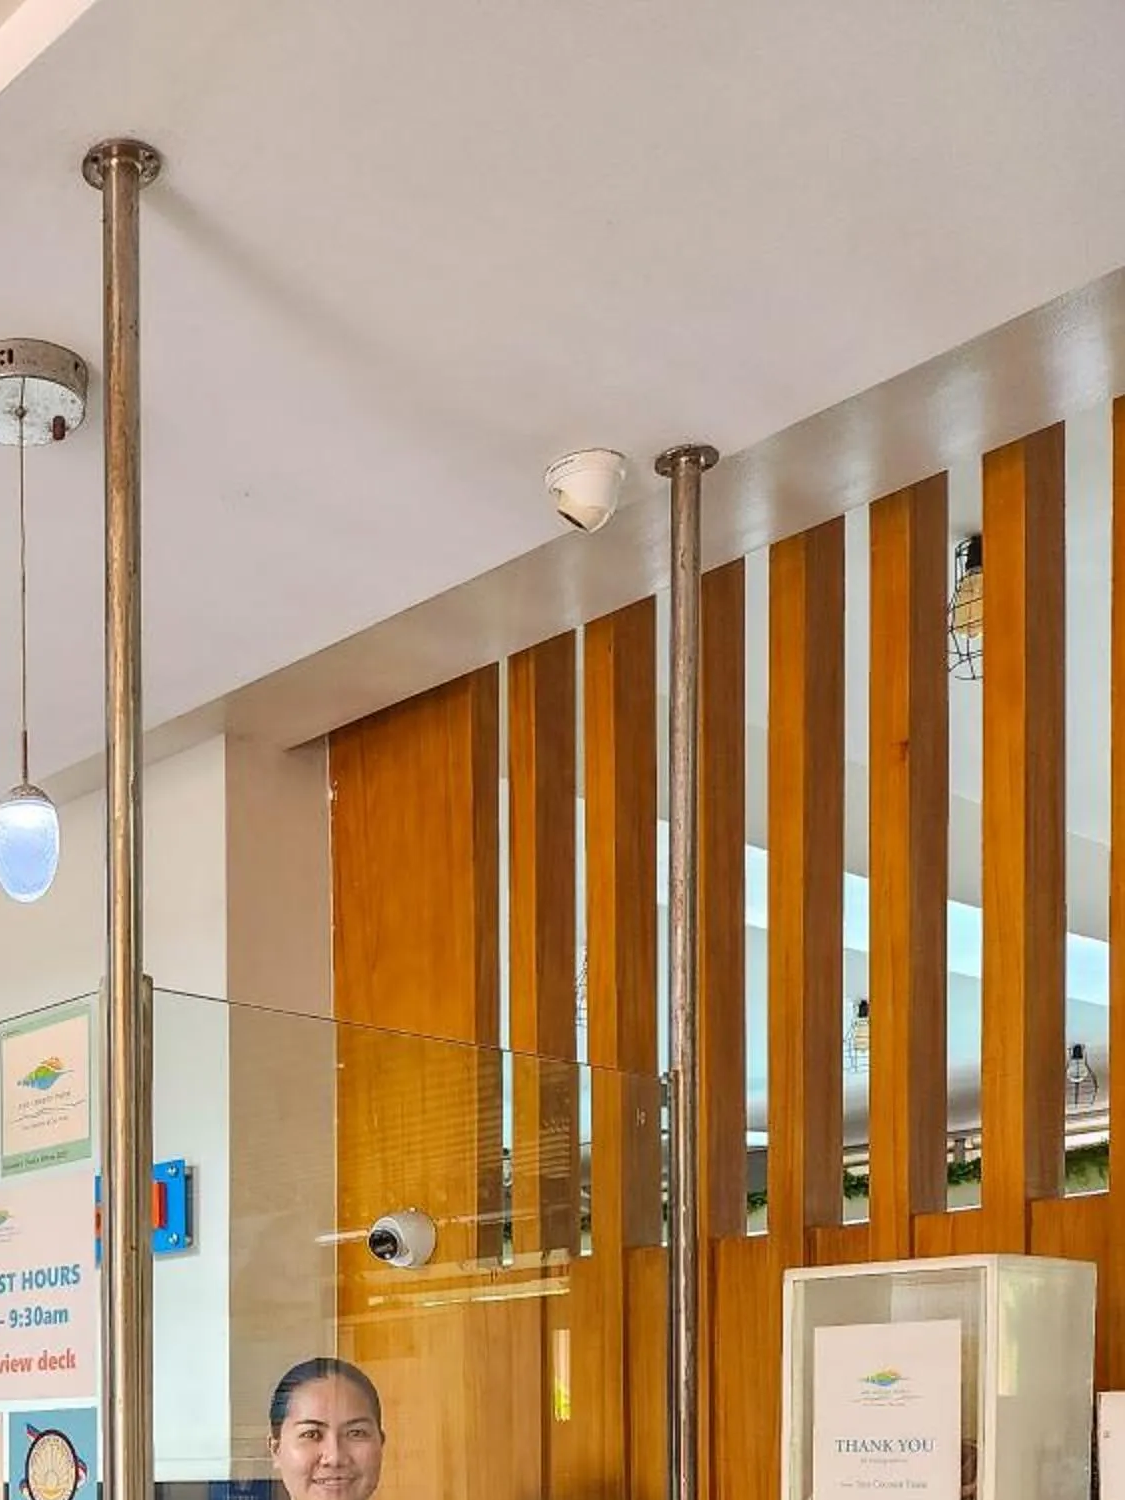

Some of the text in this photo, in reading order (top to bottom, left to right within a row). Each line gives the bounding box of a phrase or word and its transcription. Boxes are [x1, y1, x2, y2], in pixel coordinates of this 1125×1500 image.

[22, 1264, 81, 1290] HOURS
[9, 1306, 69, 1329] 9:30am
[38, 1348, 76, 1371] deck
[834, 1438, 936, 1453] THANK YOU
